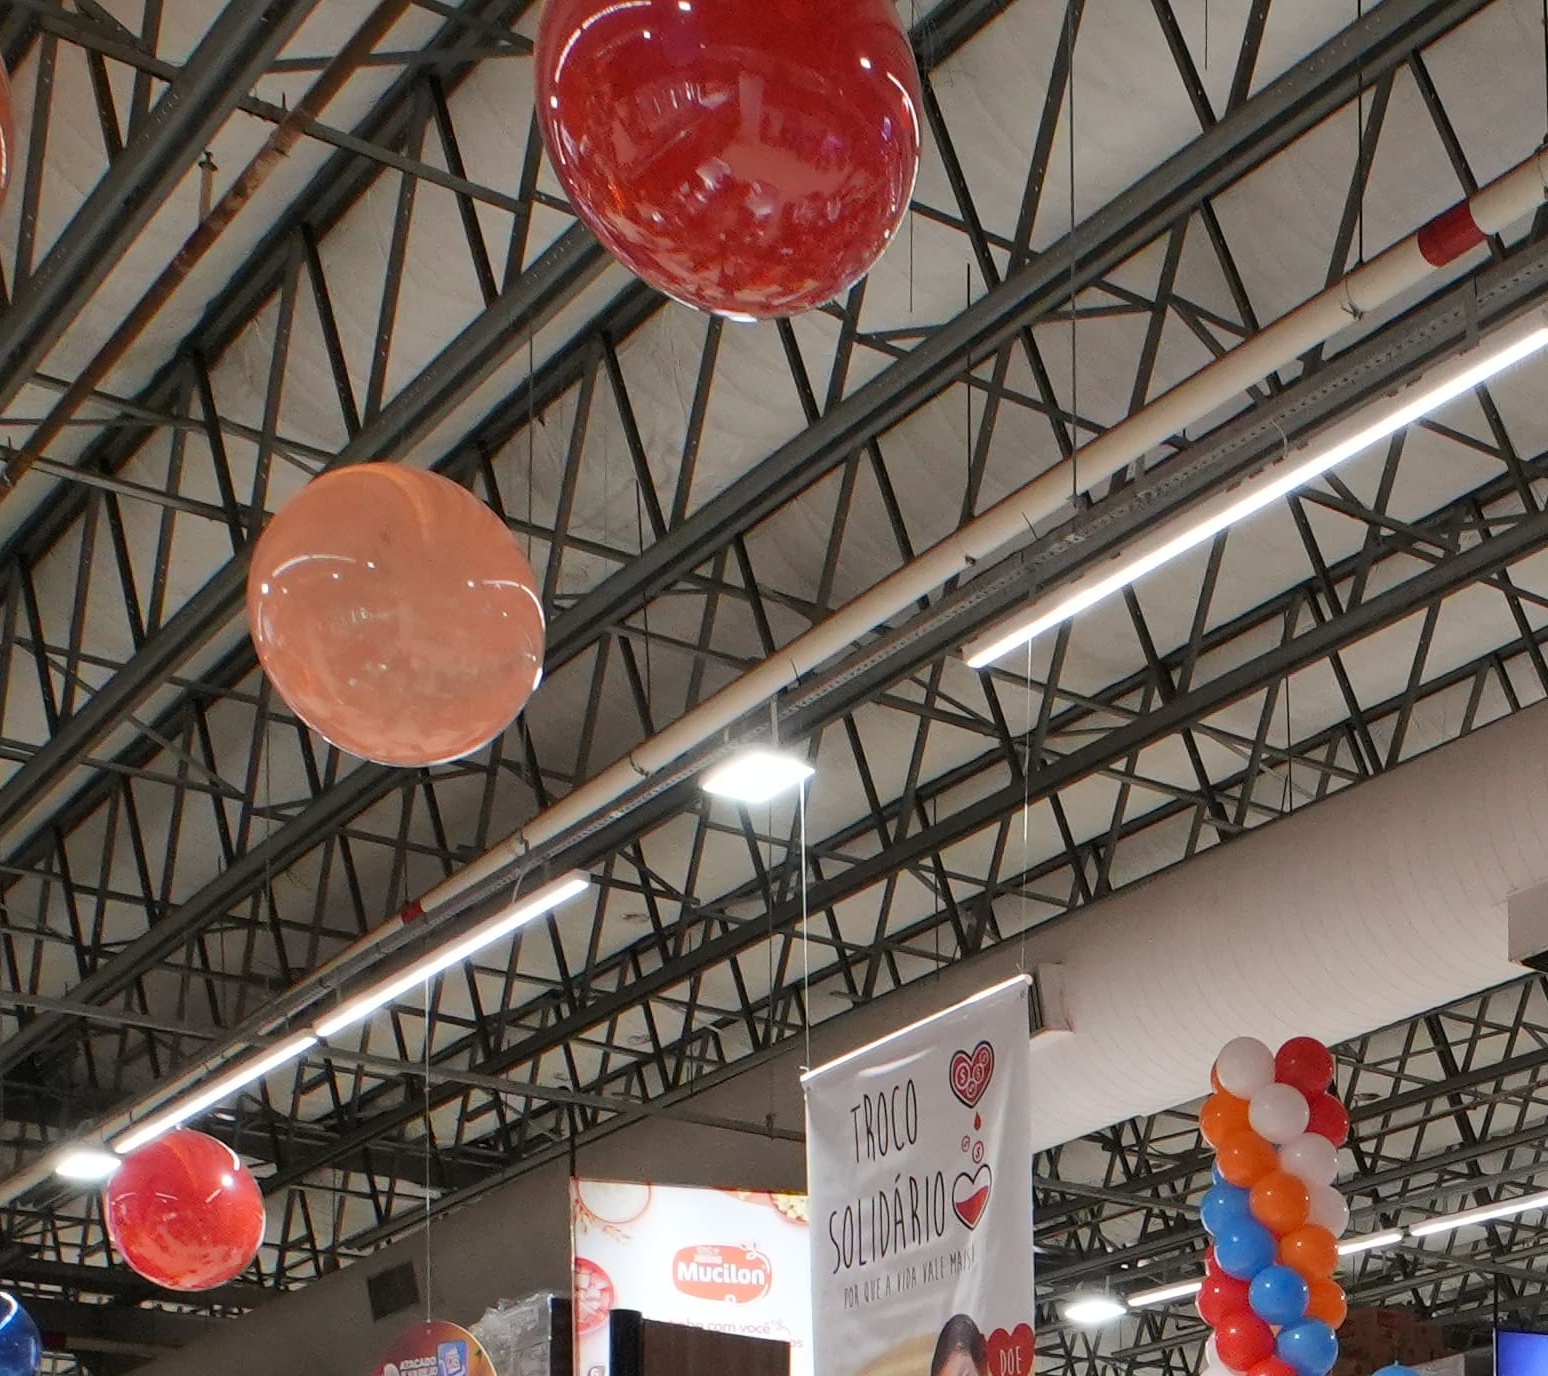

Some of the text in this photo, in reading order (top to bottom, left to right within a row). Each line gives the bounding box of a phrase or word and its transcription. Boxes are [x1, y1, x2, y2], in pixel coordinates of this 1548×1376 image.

[851, 1079, 918, 1164] TROCO
[829, 1170, 945, 1275] SOLIDÁRIO
[677, 1260, 765, 1285] Mucilon
[844, 1286, 860, 1309] POR
[864, 1281, 880, 1303] QUE
[897, 1266, 917, 1292] VIDA
[922, 1258, 945, 1286] VALE
[999, 1346, 1022, 1376] DOE
